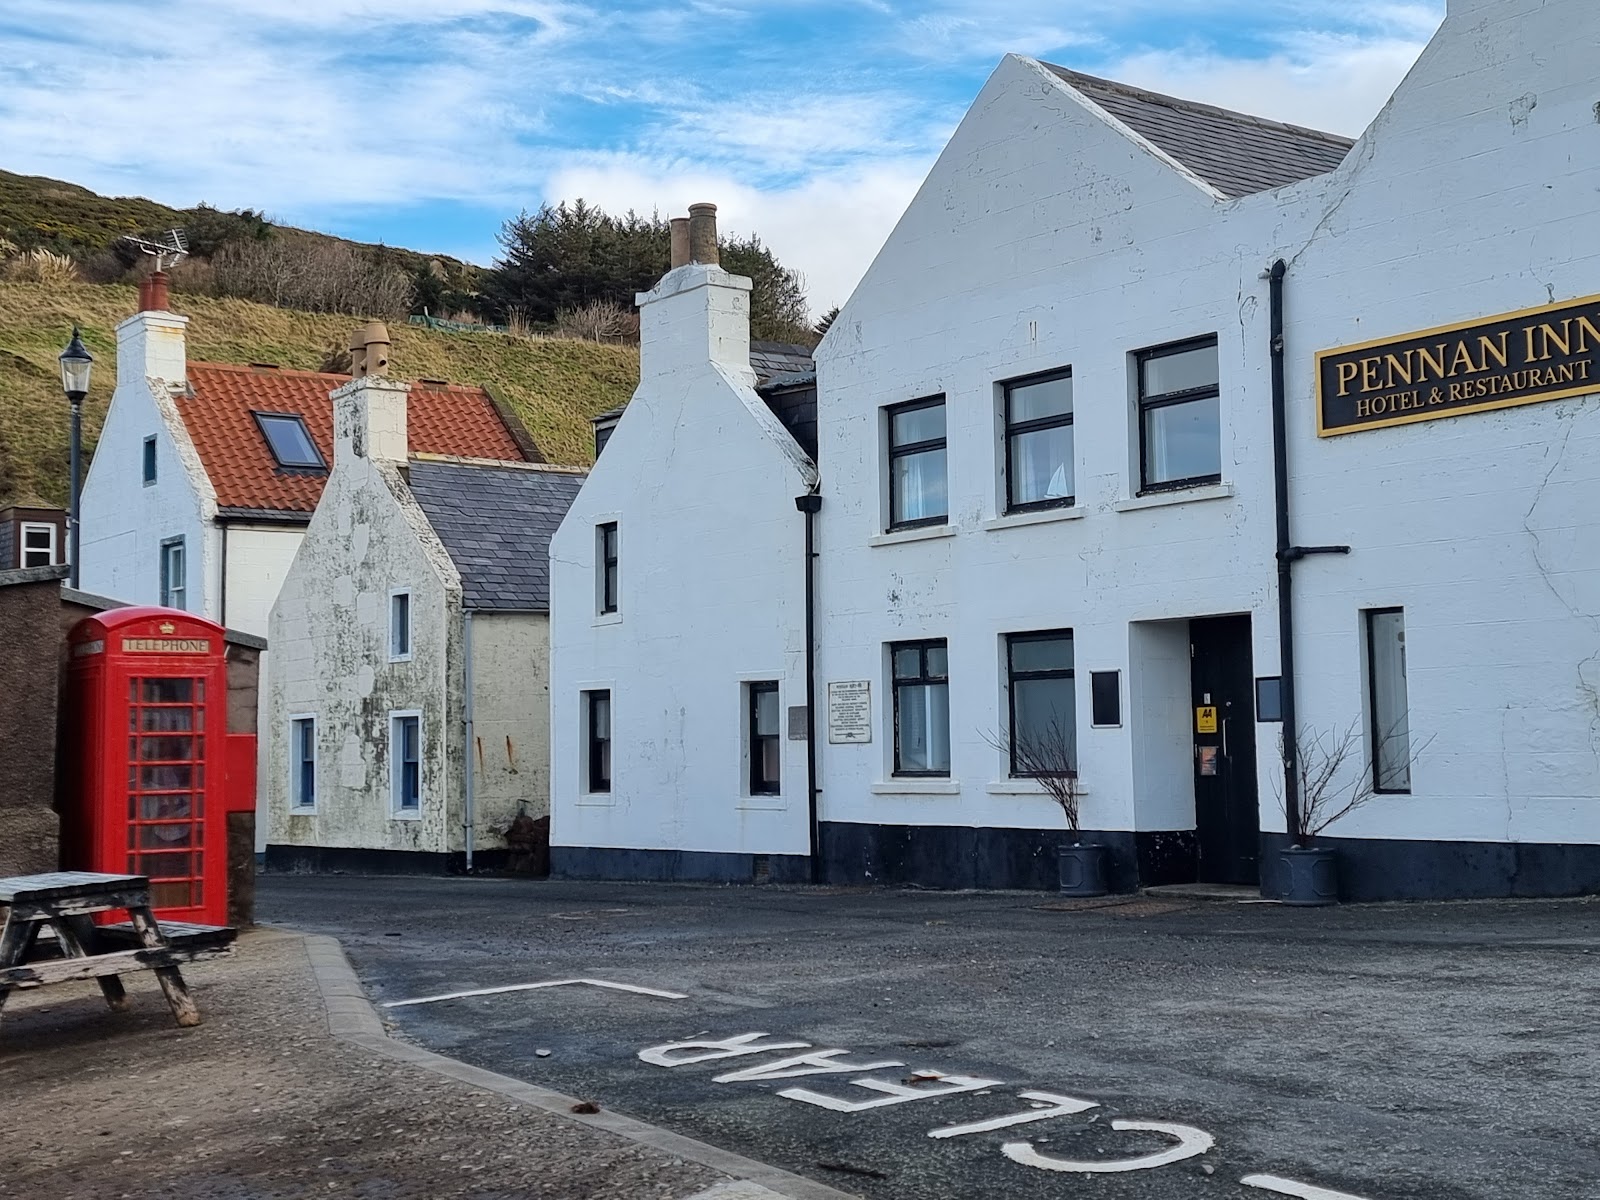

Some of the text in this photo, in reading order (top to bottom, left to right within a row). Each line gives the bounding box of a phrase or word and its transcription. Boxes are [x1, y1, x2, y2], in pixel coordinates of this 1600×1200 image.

[1336, 312, 1600, 397] PENNAN INN
[1356, 359, 1592, 418] HOTEL & RESTAURANT
[127, 640, 207, 651] TELEPHONE
[638, 1032, 1215, 1173] CLEAR
